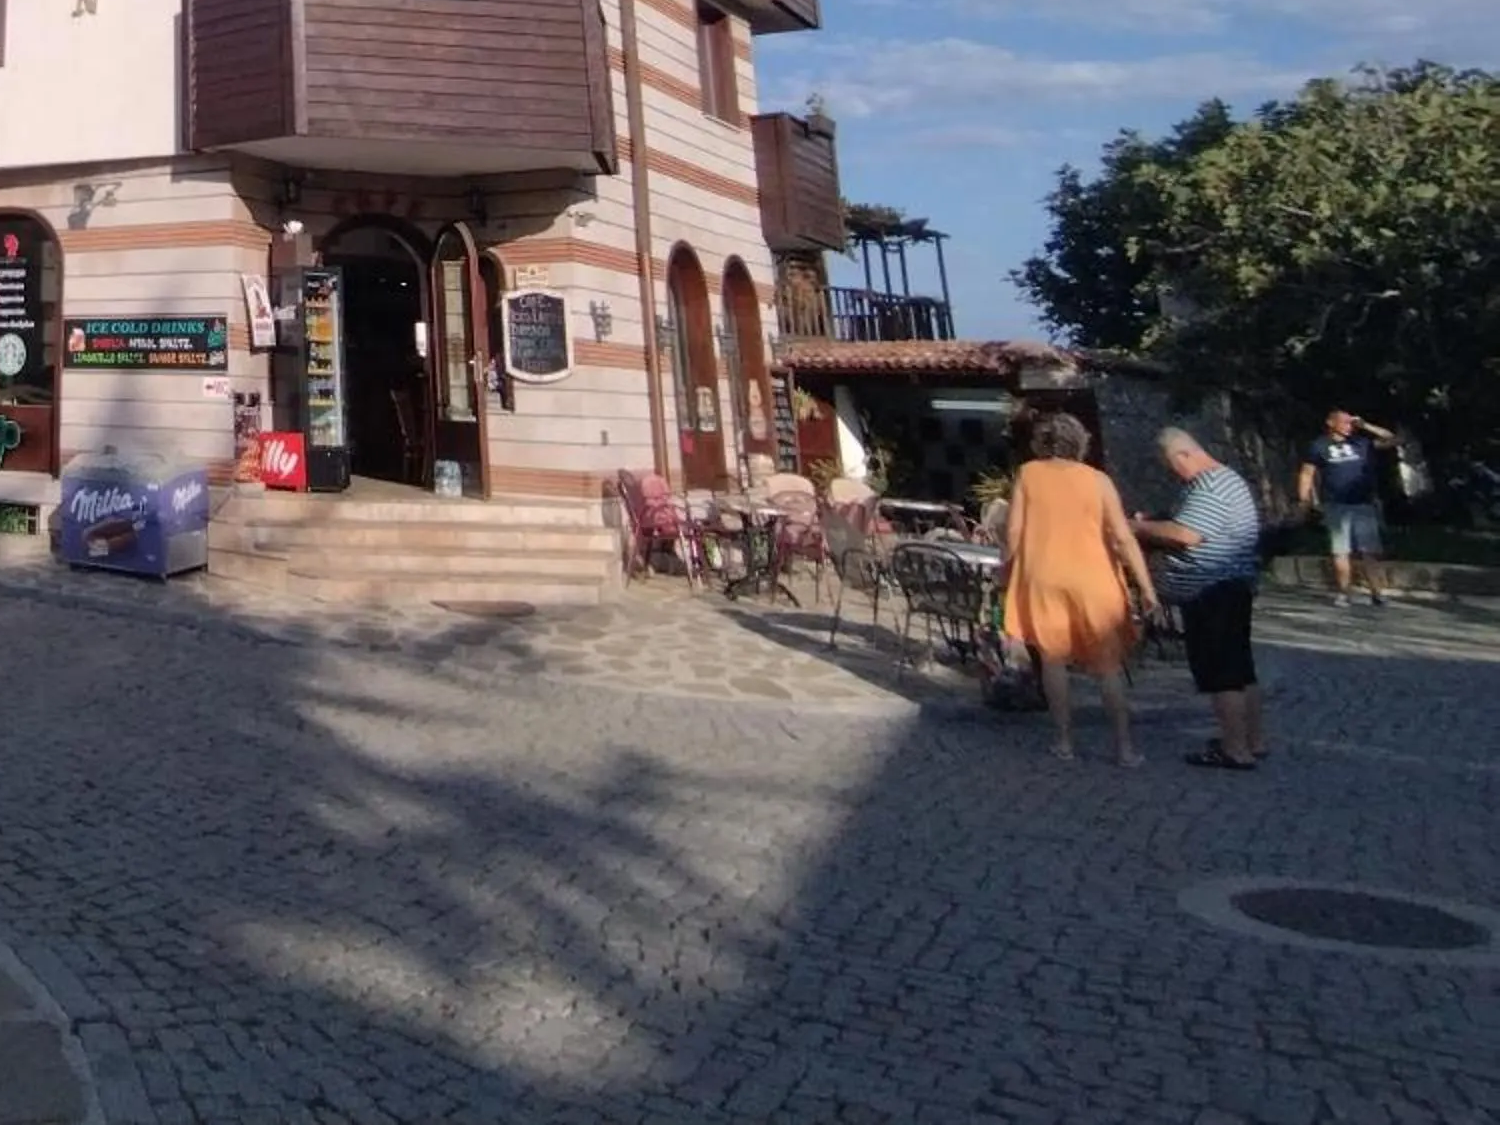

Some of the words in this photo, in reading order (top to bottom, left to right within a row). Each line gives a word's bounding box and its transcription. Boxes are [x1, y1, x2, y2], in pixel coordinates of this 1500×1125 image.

[86, 322, 109, 334] ICE
[111, 322, 149, 334] COLD
[151, 321, 205, 334] DRINKS
[262, 440, 298, 479] illy
[71, 486, 134, 523] Milka
